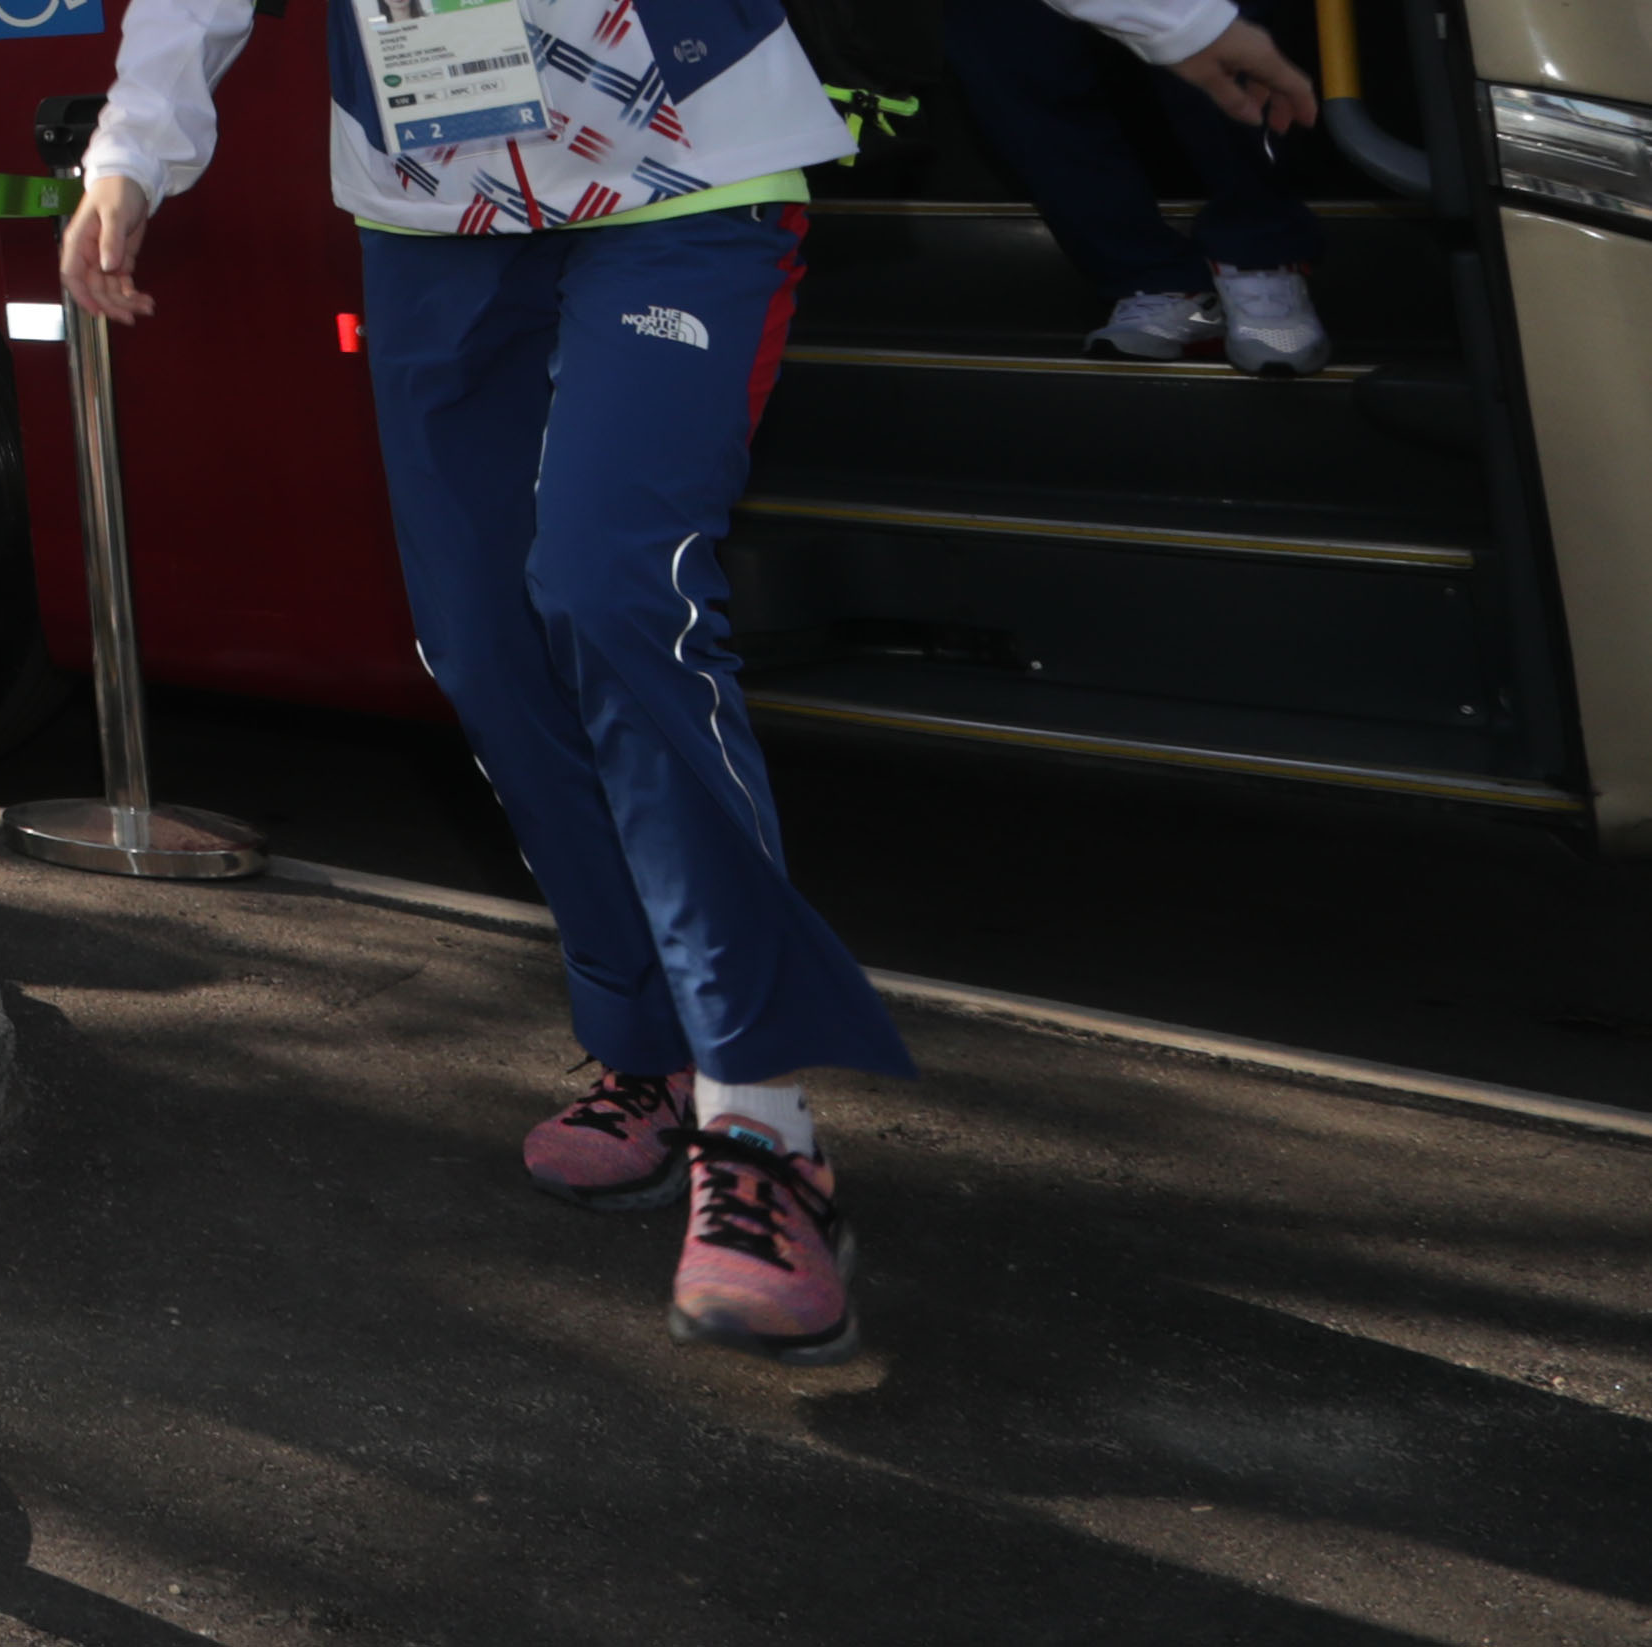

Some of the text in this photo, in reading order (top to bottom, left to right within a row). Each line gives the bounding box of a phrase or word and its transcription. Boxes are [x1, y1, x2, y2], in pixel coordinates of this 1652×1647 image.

[404, 108, 536, 141] A 2 R
[648, 305, 681, 320] THE
[621, 313, 680, 331] NORTH
[636, 324, 679, 340] FACE
